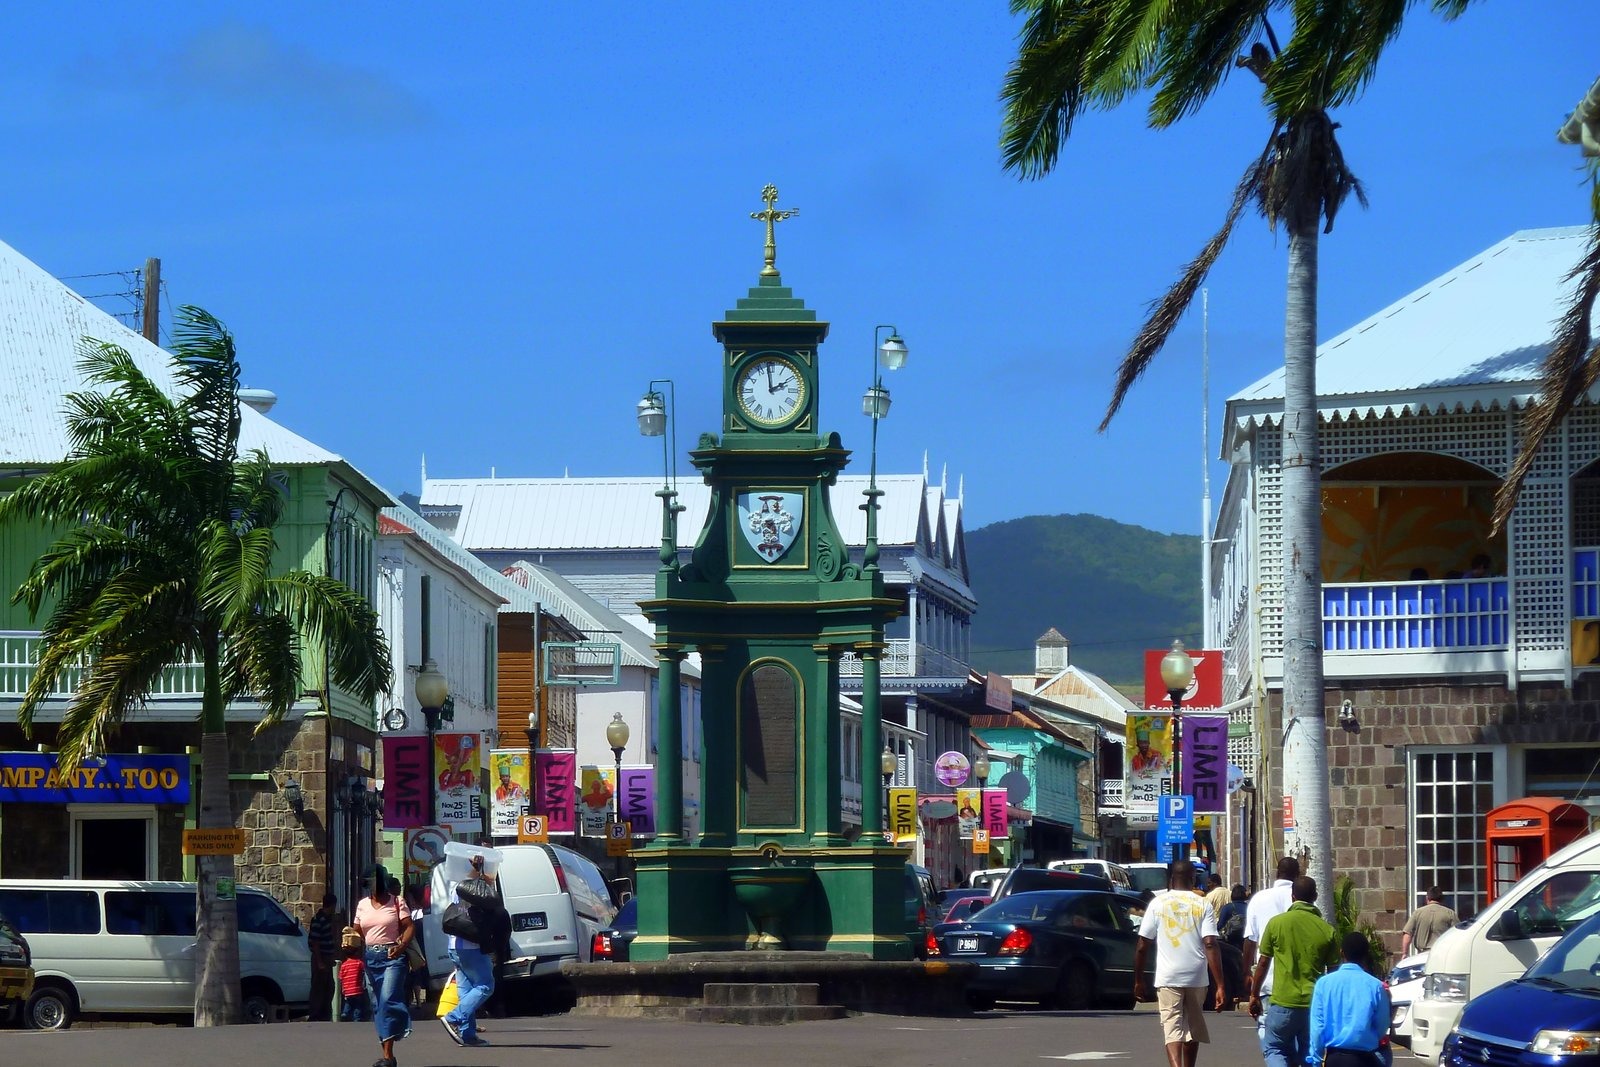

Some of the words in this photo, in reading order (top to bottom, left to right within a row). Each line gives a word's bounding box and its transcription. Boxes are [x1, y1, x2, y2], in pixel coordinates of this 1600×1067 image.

[0, 767, 179, 789] MPANY...TOO
[394, 745, 420, 818] LIME
[1193, 726, 1219, 801] LIME
[545, 760, 567, 822] LIME
[628, 775, 648, 827] LIME
[1162, 779, 1171, 796] LIM
[471, 796, 480, 818] LIME
[896, 794, 911, 834] LIME
[989, 795, 1004, 833] LIME
[1169, 798, 1185, 817] P
[959, 939, 964, 949] P
